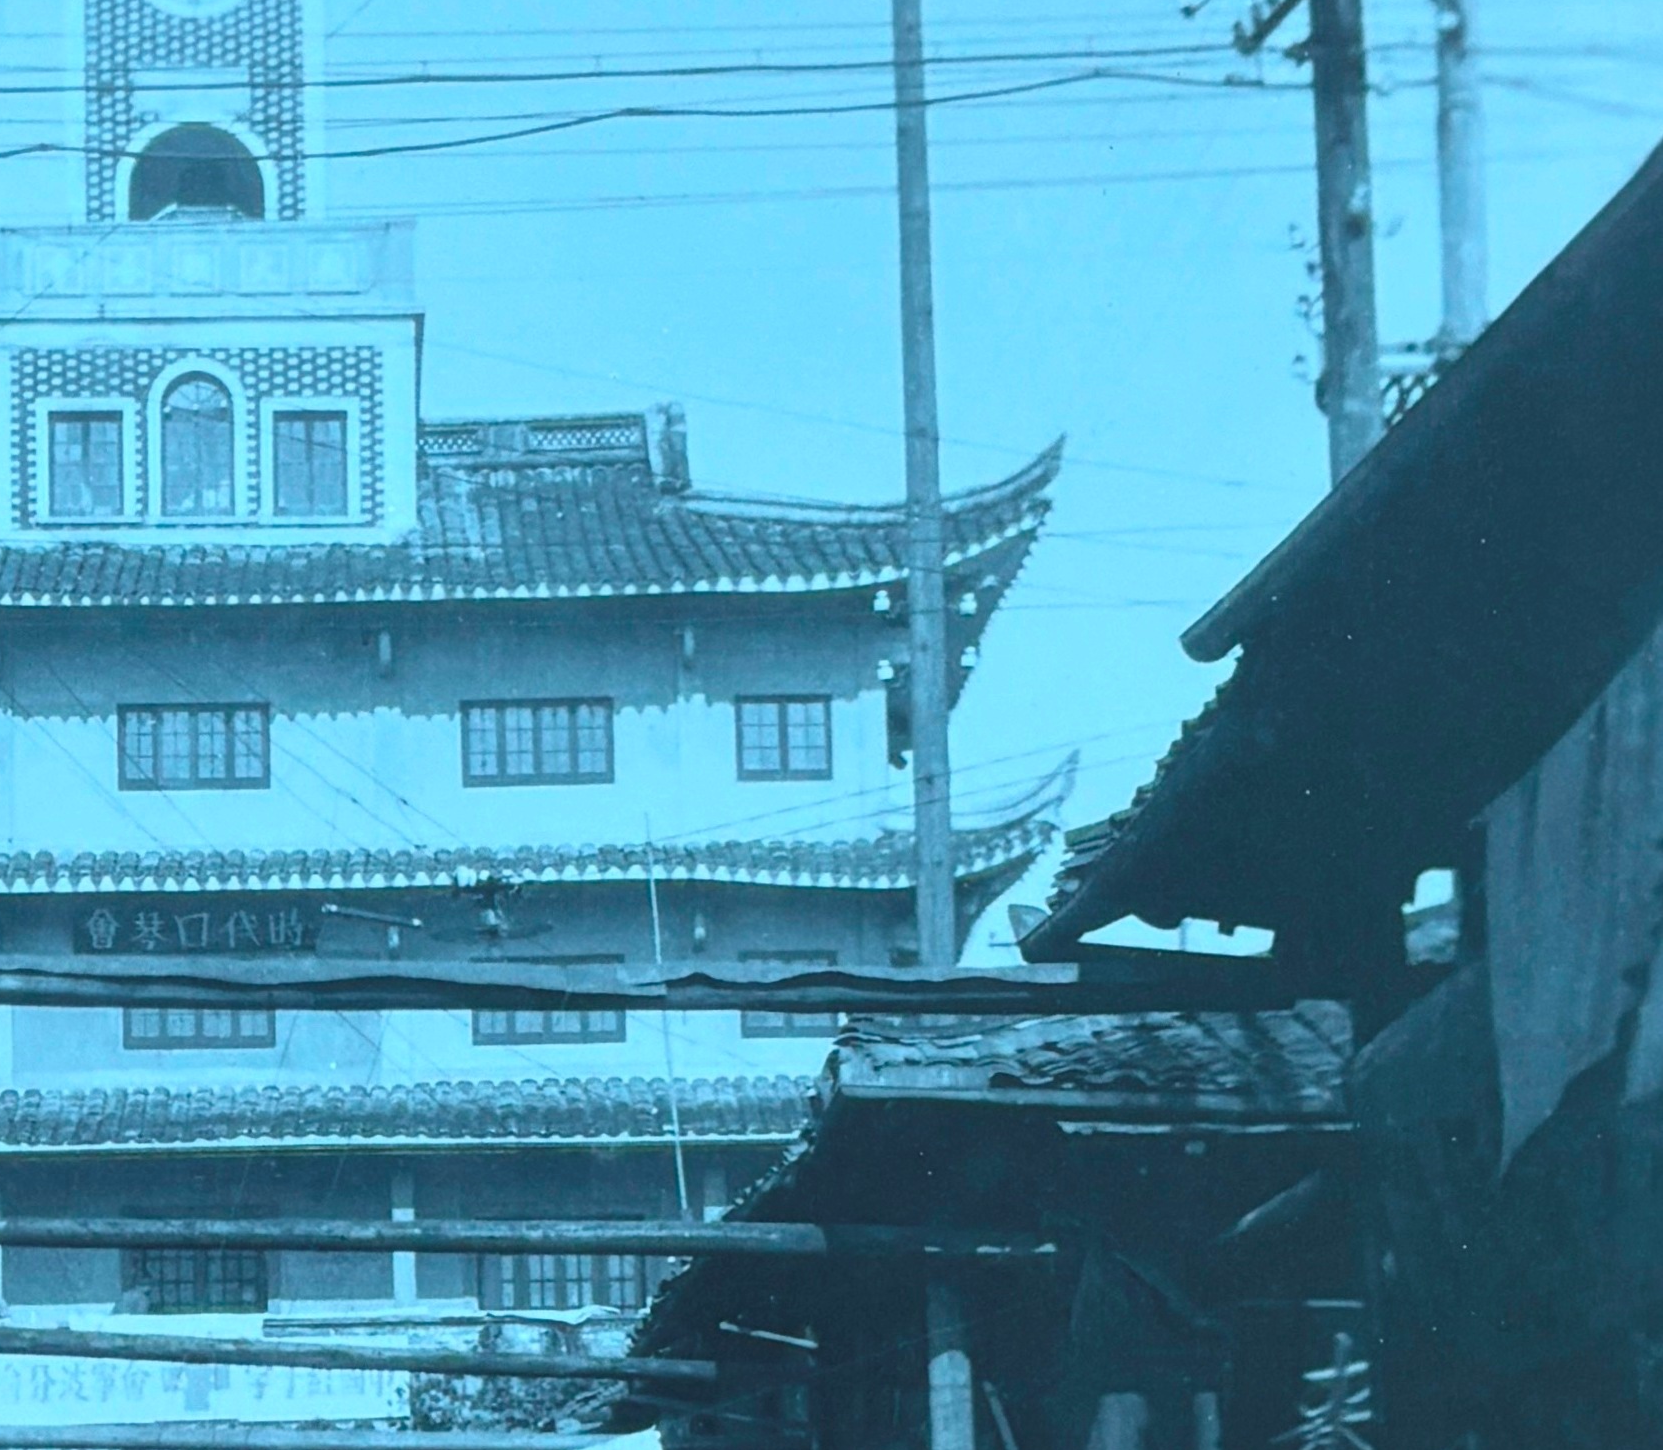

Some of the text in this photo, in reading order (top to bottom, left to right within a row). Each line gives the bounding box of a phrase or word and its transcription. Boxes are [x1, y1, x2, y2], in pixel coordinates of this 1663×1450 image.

[85, 907, 303, 950] 時代口琴會
